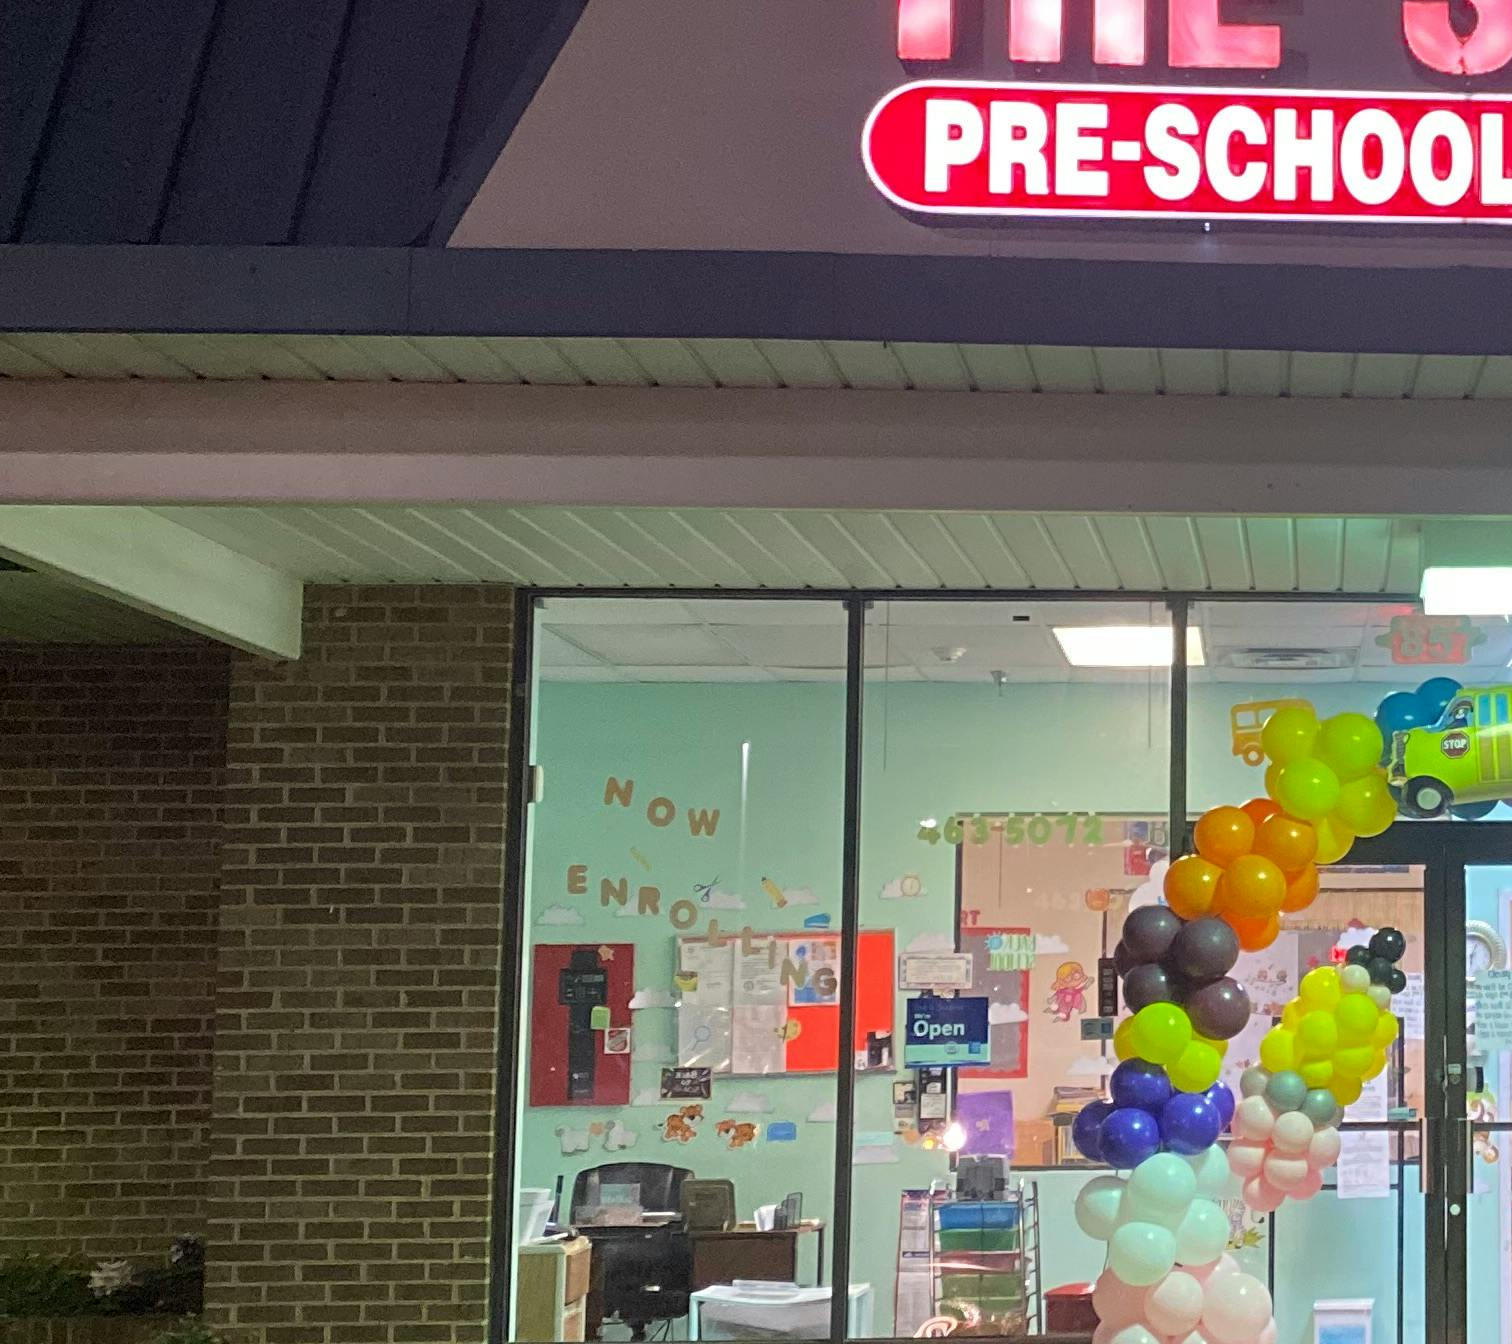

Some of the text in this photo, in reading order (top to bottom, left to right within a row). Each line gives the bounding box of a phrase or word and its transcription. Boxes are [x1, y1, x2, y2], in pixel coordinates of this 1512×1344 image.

[1443, 738, 1468, 750] STOP
[604, 776, 720, 837] NOW
[567, 865, 837, 996] ENROLLING
[913, 1020, 965, 1040] Open
